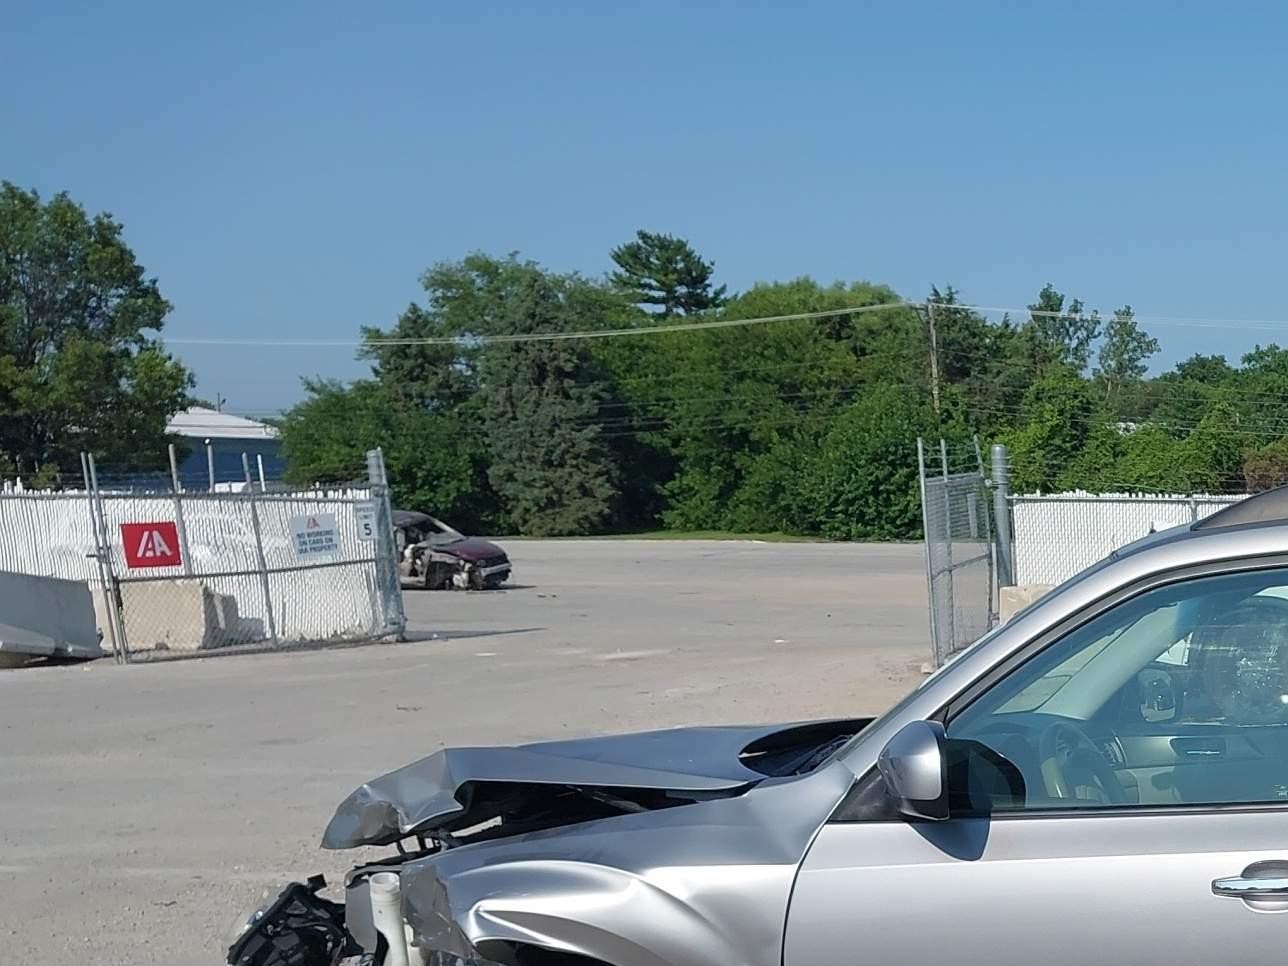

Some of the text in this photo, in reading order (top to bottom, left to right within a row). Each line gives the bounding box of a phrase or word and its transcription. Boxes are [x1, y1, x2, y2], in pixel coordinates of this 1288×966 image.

[363, 523, 372, 536] 5
[307, 530, 333, 538] WORKING
[310, 544, 337, 552] PROPERTY
